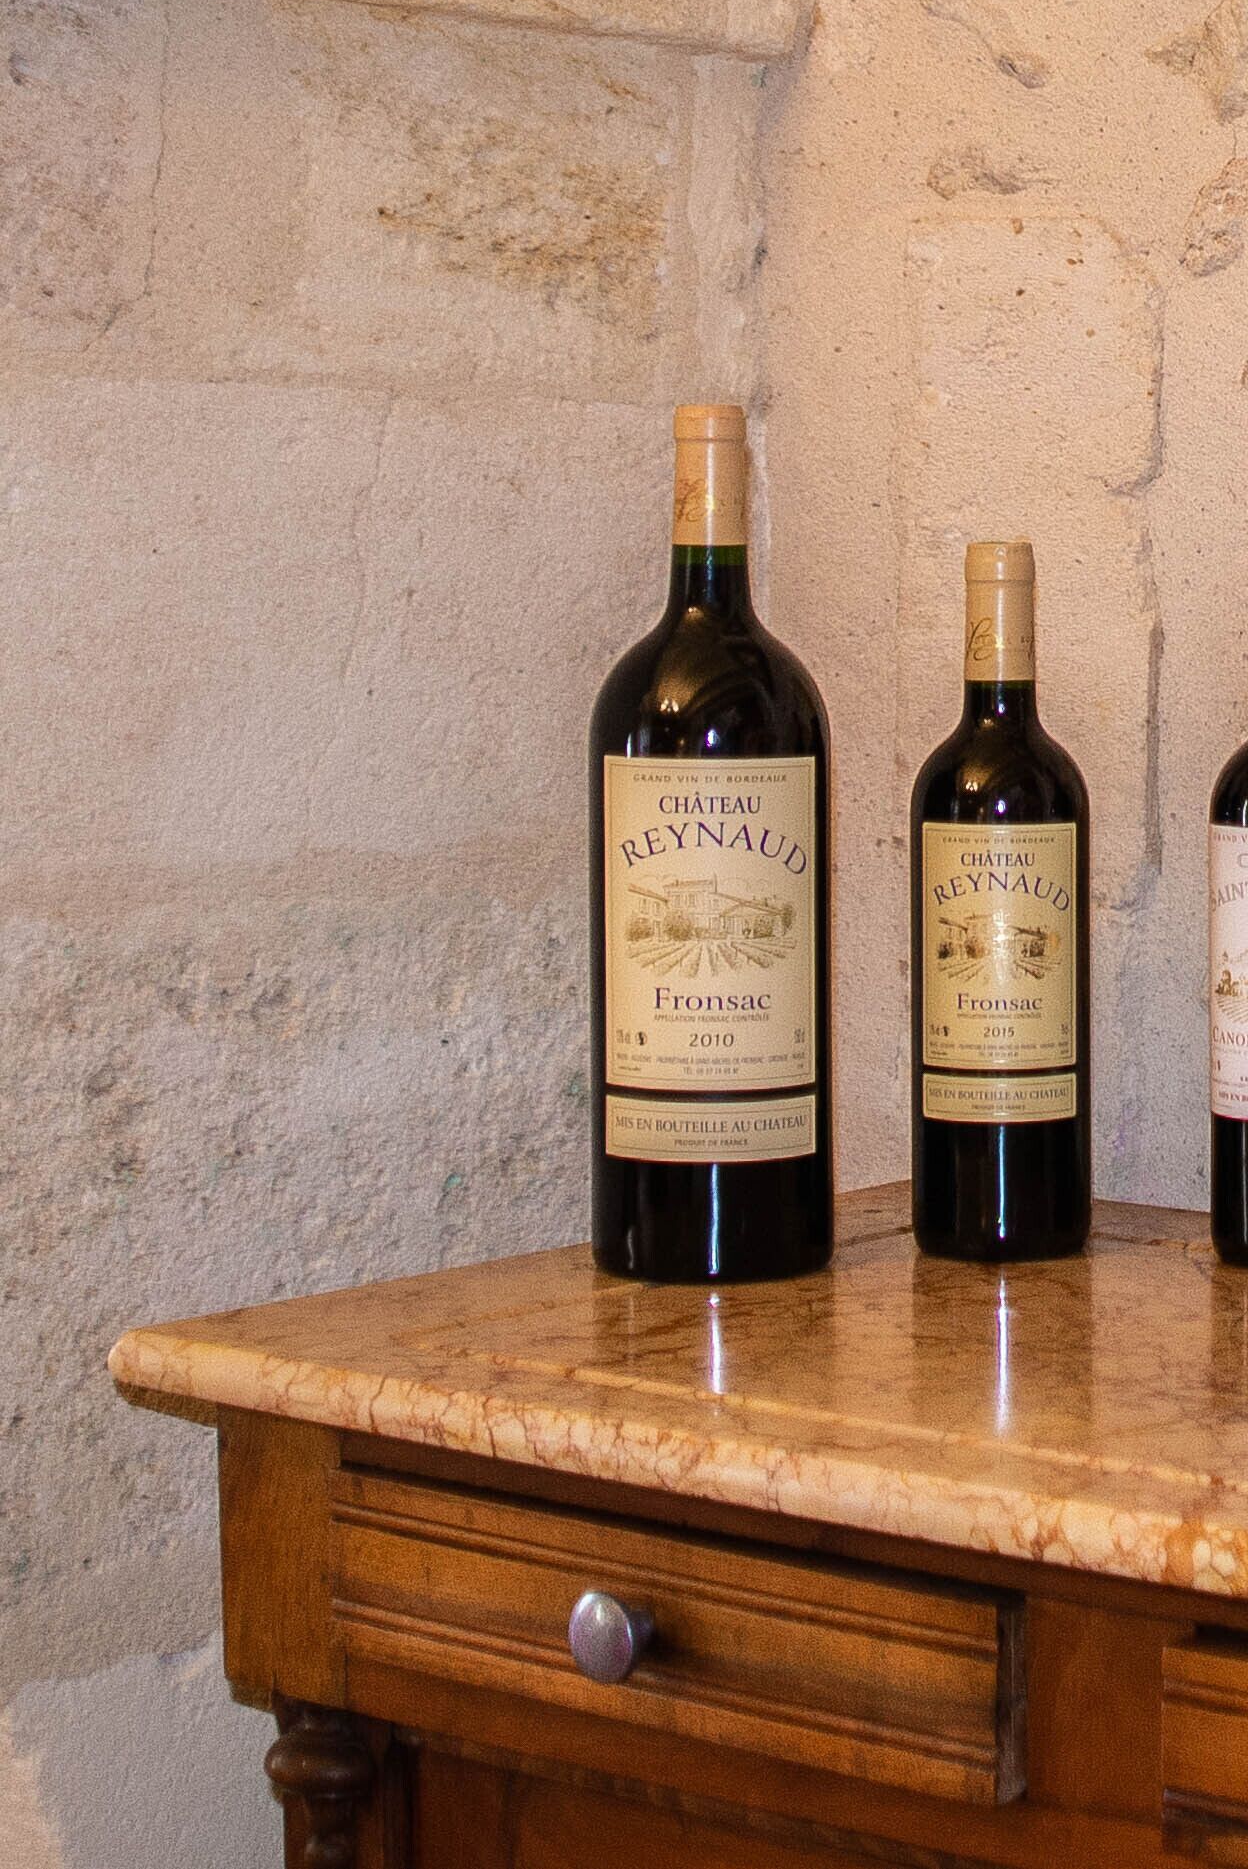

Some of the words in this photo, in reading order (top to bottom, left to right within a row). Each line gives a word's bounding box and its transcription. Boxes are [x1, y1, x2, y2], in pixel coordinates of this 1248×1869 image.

[633, 773, 671, 782] GRAND
[677, 774, 698, 782] VIN
[726, 774, 788, 783] BORDEAUX
[659, 791, 761, 814] CHÂTEAU
[619, 820, 807, 875] REYNAUD
[960, 849, 1036, 867] CHÂTEAU
[933, 871, 1070, 912] REYNAUD
[655, 986, 772, 1012] Fronsac
[957, 992, 1043, 1011] Fronsac
[688, 1033, 735, 1048] 2010
[983, 1025, 1015, 1038] 2015
[944, 1089, 956, 1099] EN
[958, 1089, 1010, 1101] BOUTEILLE
[1012, 1090, 1026, 1100] AU
[1230, 1092, 1240, 1102] EN
[615, 1115, 634, 1129] MIS
[636, 1117, 651, 1129] EN
[655, 1118, 726, 1133] BOUTEILLE
[732, 1119, 750, 1132] AU
